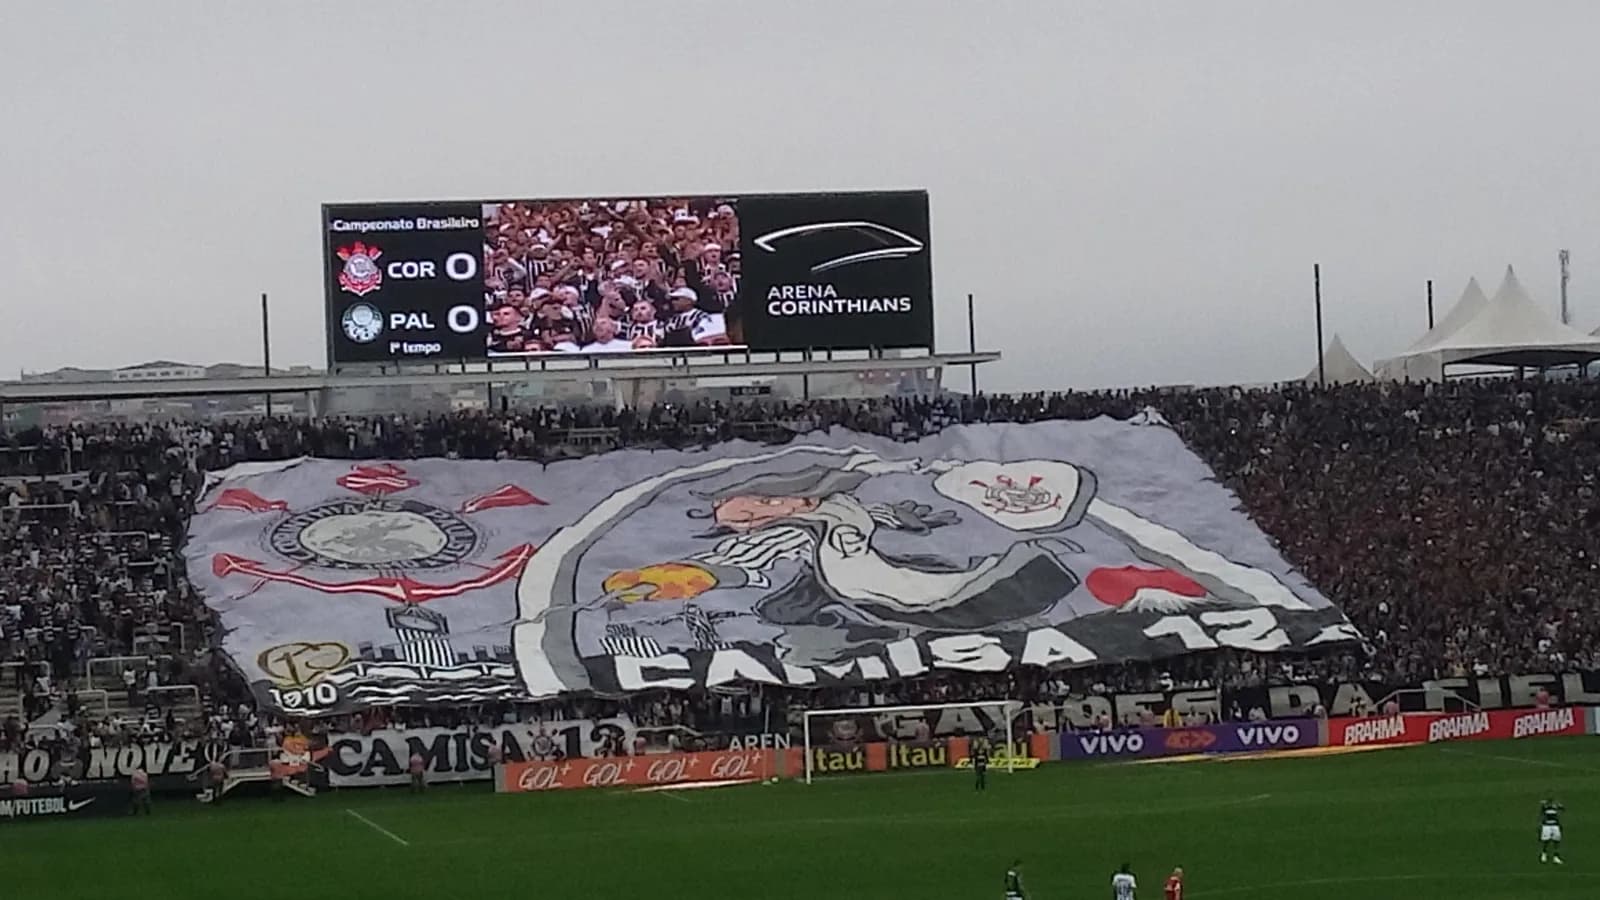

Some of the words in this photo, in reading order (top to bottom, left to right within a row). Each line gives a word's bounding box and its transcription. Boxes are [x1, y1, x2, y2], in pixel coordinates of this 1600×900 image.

[333, 220, 414, 233] Campeonato
[417, 217, 480, 230] Brasileiro
[387, 262, 436, 279] COR
[446, 252, 477, 281] 0
[767, 284, 838, 300] ARENA
[390, 313, 435, 330] PAL
[448, 305, 479, 333] 0
[767, 297, 912, 316] CORINTHIANS
[403, 342, 441, 356] tempo
[615, 626, 1098, 691] CAMISA
[1143, 606, 1292, 651] 12
[1268, 684, 1381, 717] DA
[1237, 724, 1299, 745] VIVO
[1345, 716, 1405, 745] BRAHMA
[1429, 712, 1489, 742] BRAHMA
[1514, 708, 1575, 738] BRAHMA
[328, 724, 526, 778] CAMISA
[890, 738, 946, 767] Itaú
